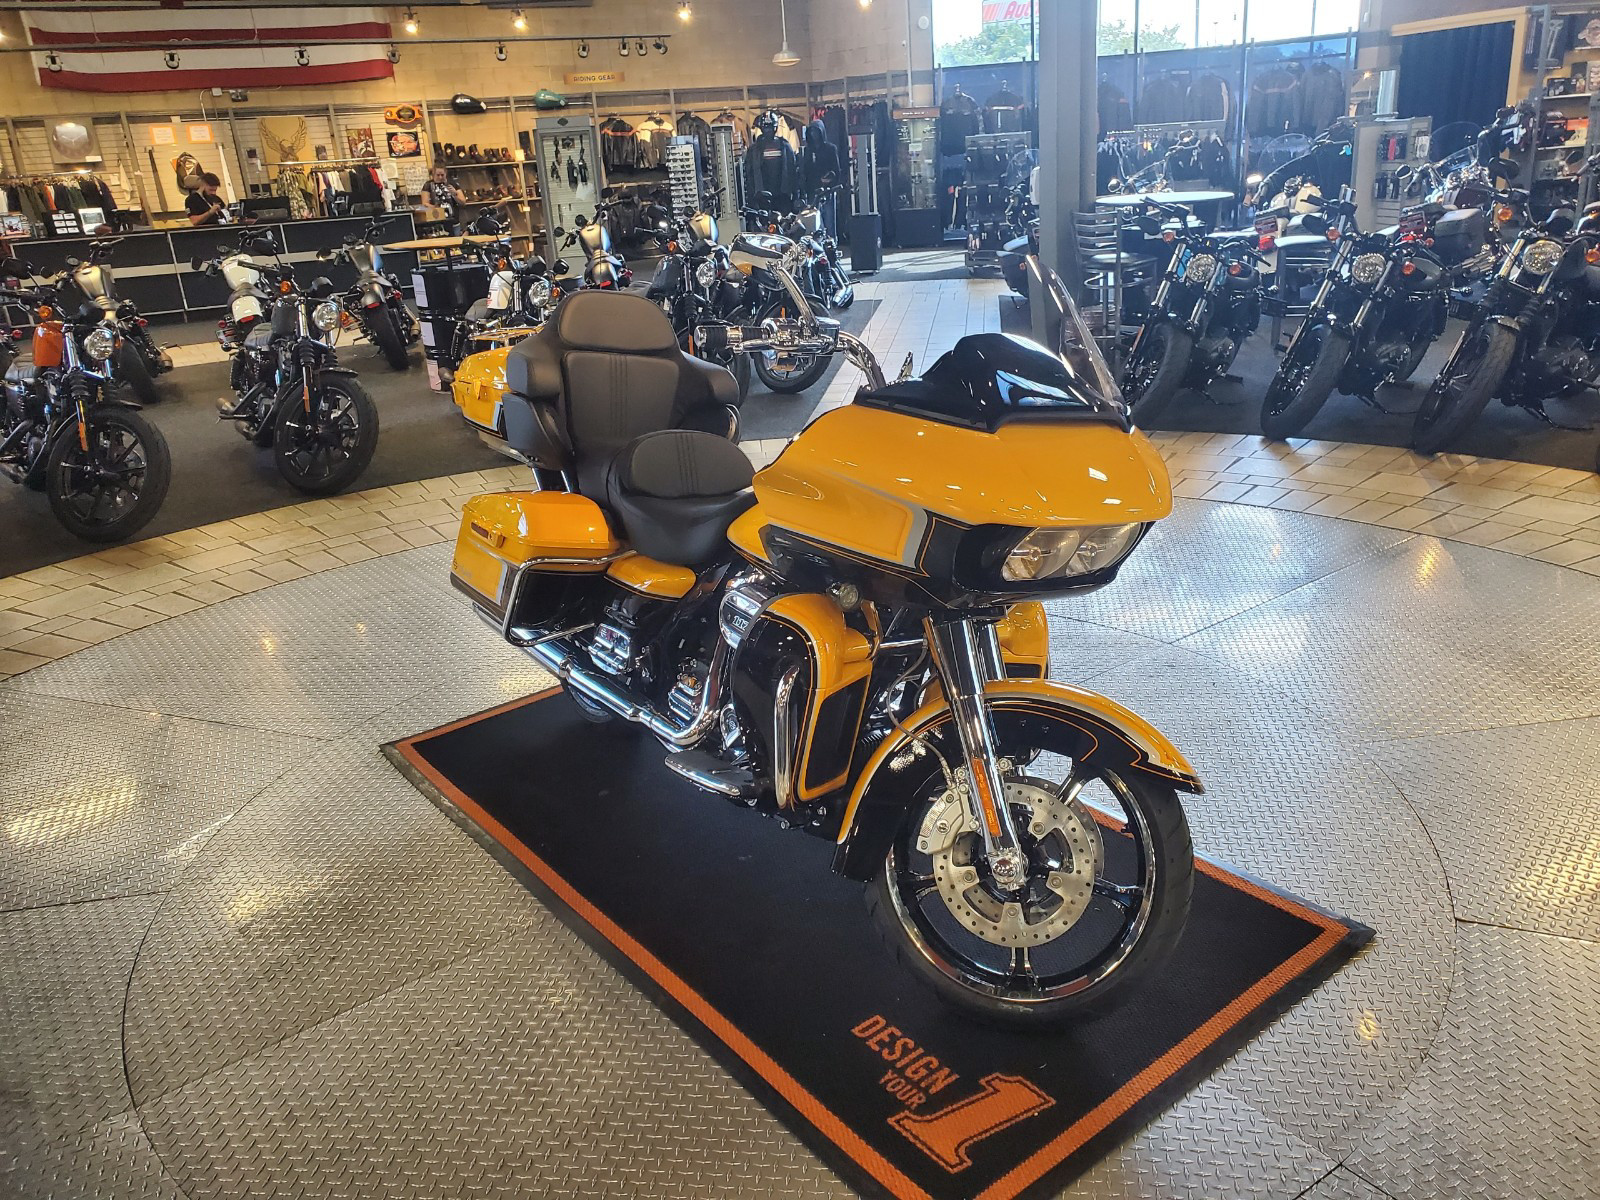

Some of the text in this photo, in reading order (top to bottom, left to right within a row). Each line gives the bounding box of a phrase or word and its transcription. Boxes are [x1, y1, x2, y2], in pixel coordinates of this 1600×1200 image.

[851, 1014, 960, 1095] DESIGN
[879, 1069, 927, 1110] YOUR
[887, 1073, 1057, 1174] 1
